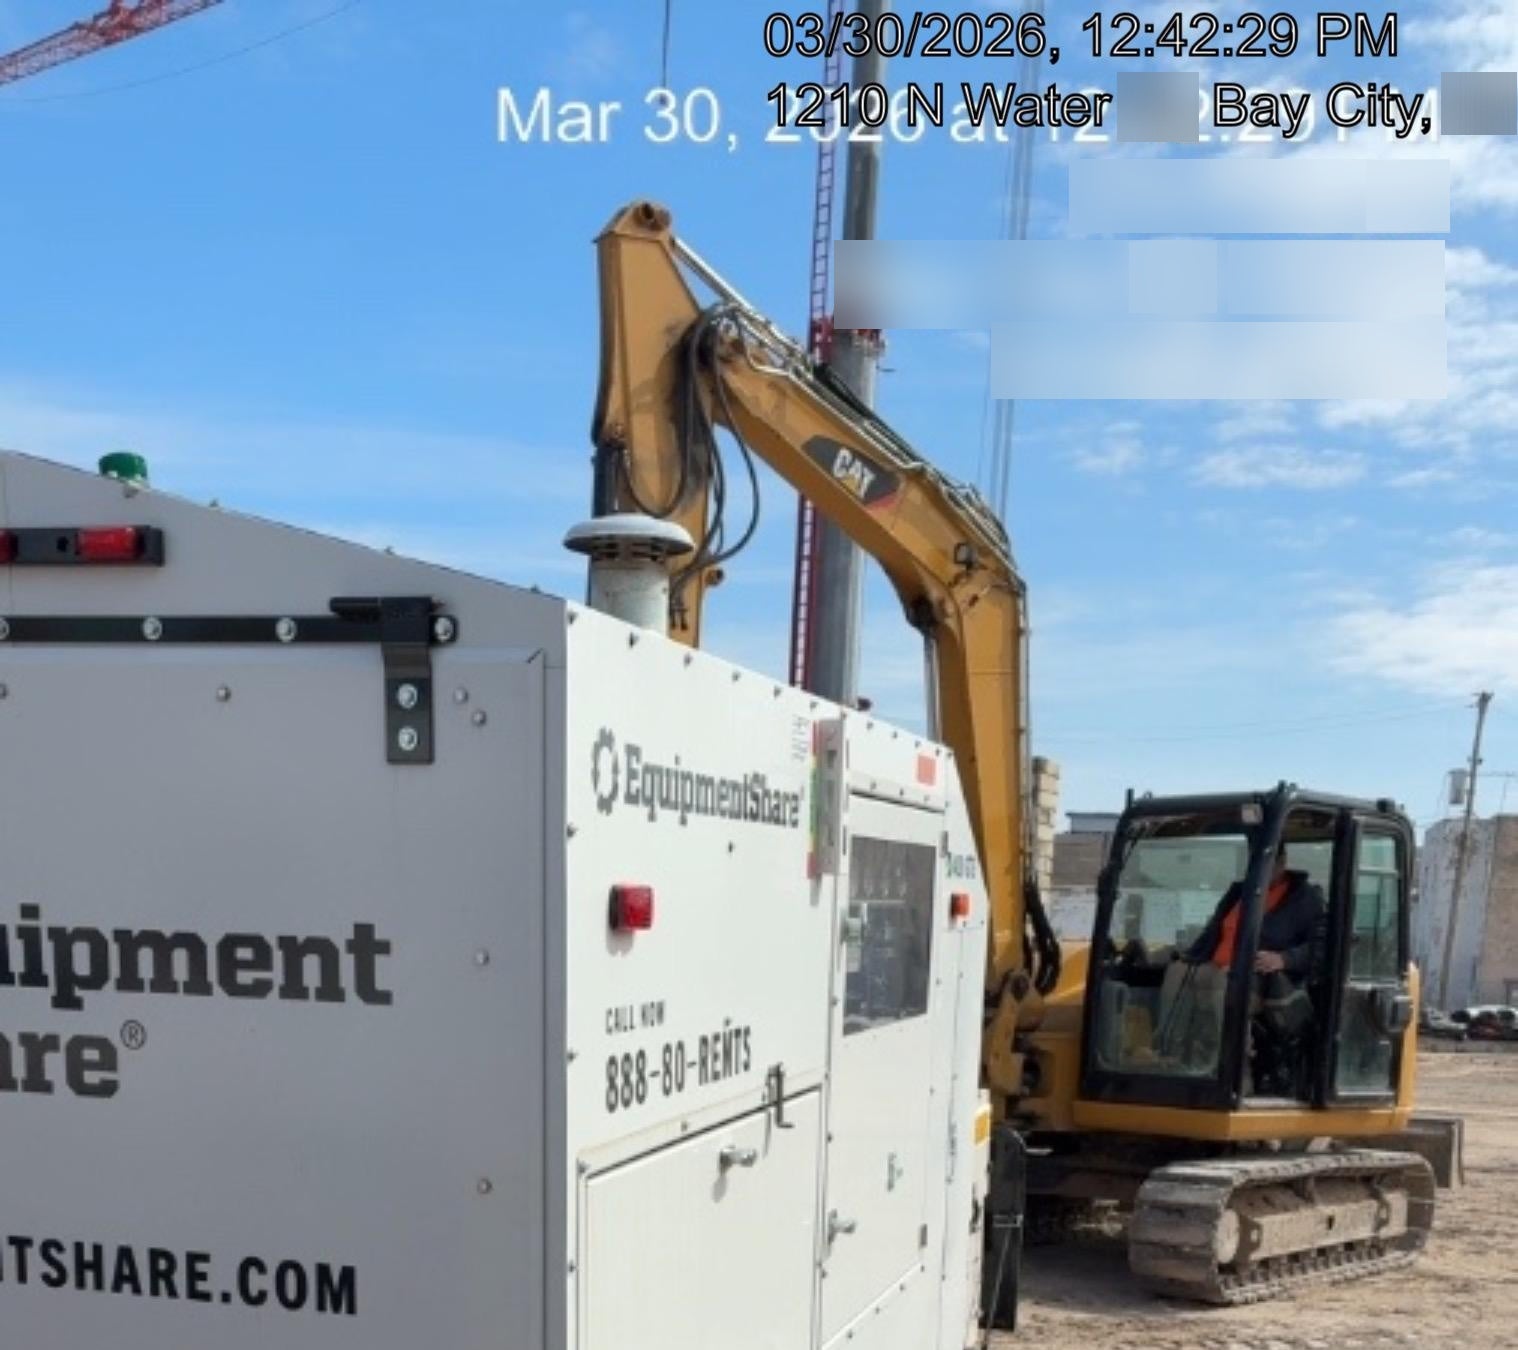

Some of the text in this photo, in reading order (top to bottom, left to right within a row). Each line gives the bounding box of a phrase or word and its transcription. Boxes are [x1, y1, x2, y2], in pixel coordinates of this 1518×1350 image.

[833, 447, 876, 499] CAT
[623, 742, 800, 829] EquipmentShare
[0, 903, 393, 1012] ipment
[605, 1000, 665, 1036] CALL NOW
[605, 1025, 752, 1114] 888-80-RENTS
[0, 1234, 358, 1316] TSHARE.COM
